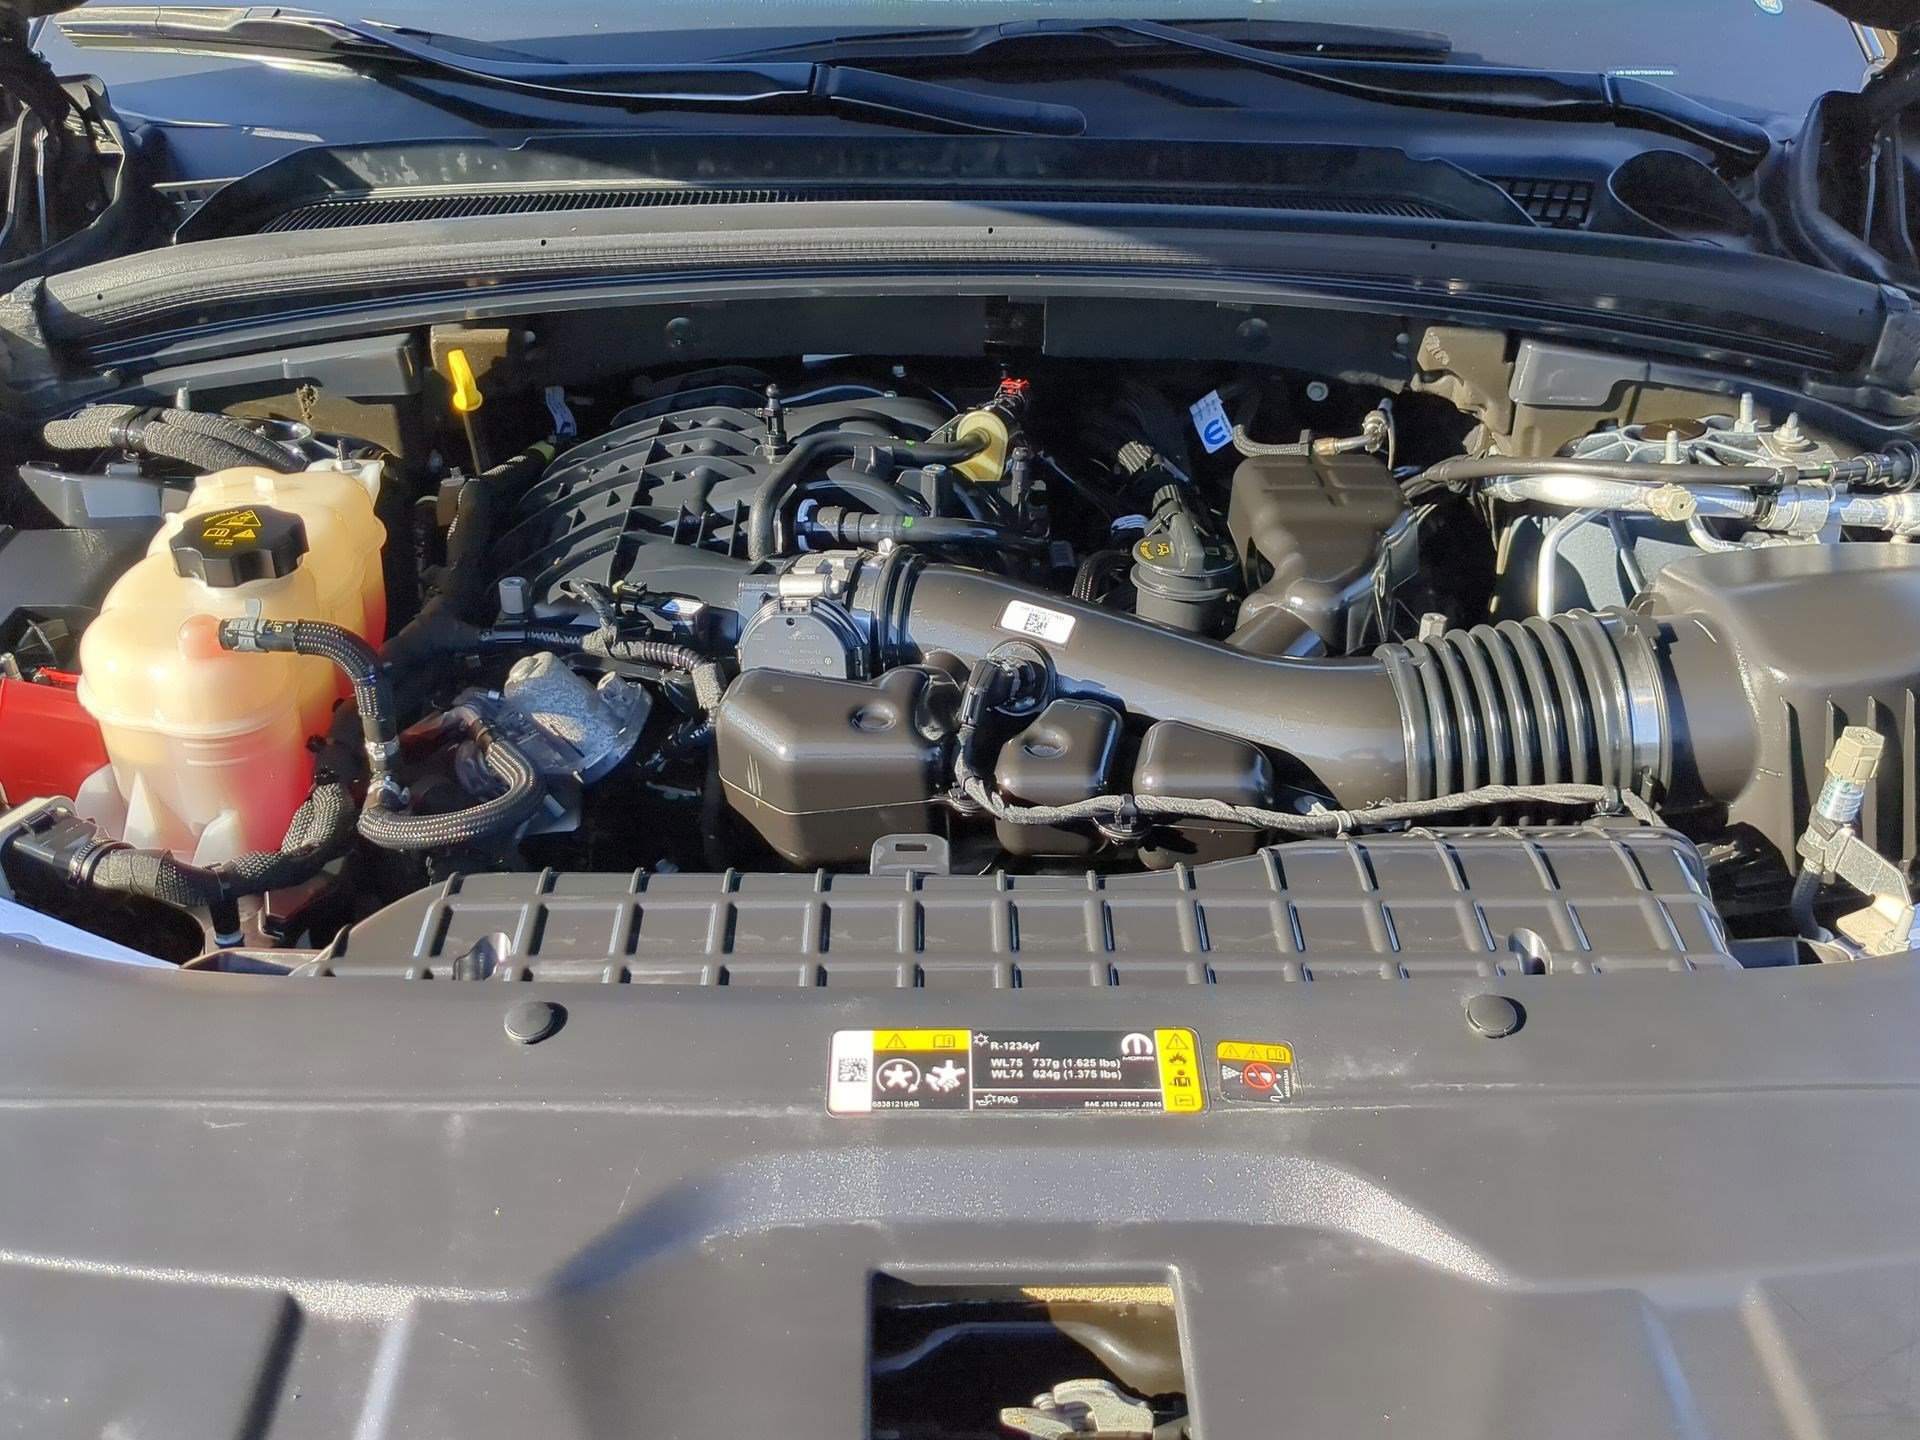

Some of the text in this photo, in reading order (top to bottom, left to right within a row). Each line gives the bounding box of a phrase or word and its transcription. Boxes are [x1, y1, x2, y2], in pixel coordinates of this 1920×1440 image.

[990, 1041, 1040, 1052] R-1234yf
[990, 1058, 1121, 1069] WL75 737g (1.625 lbs)
[991, 1069, 1122, 1080] WL74 624g (1.375 lbs)
[997, 1095, 1019, 1104] PAG
